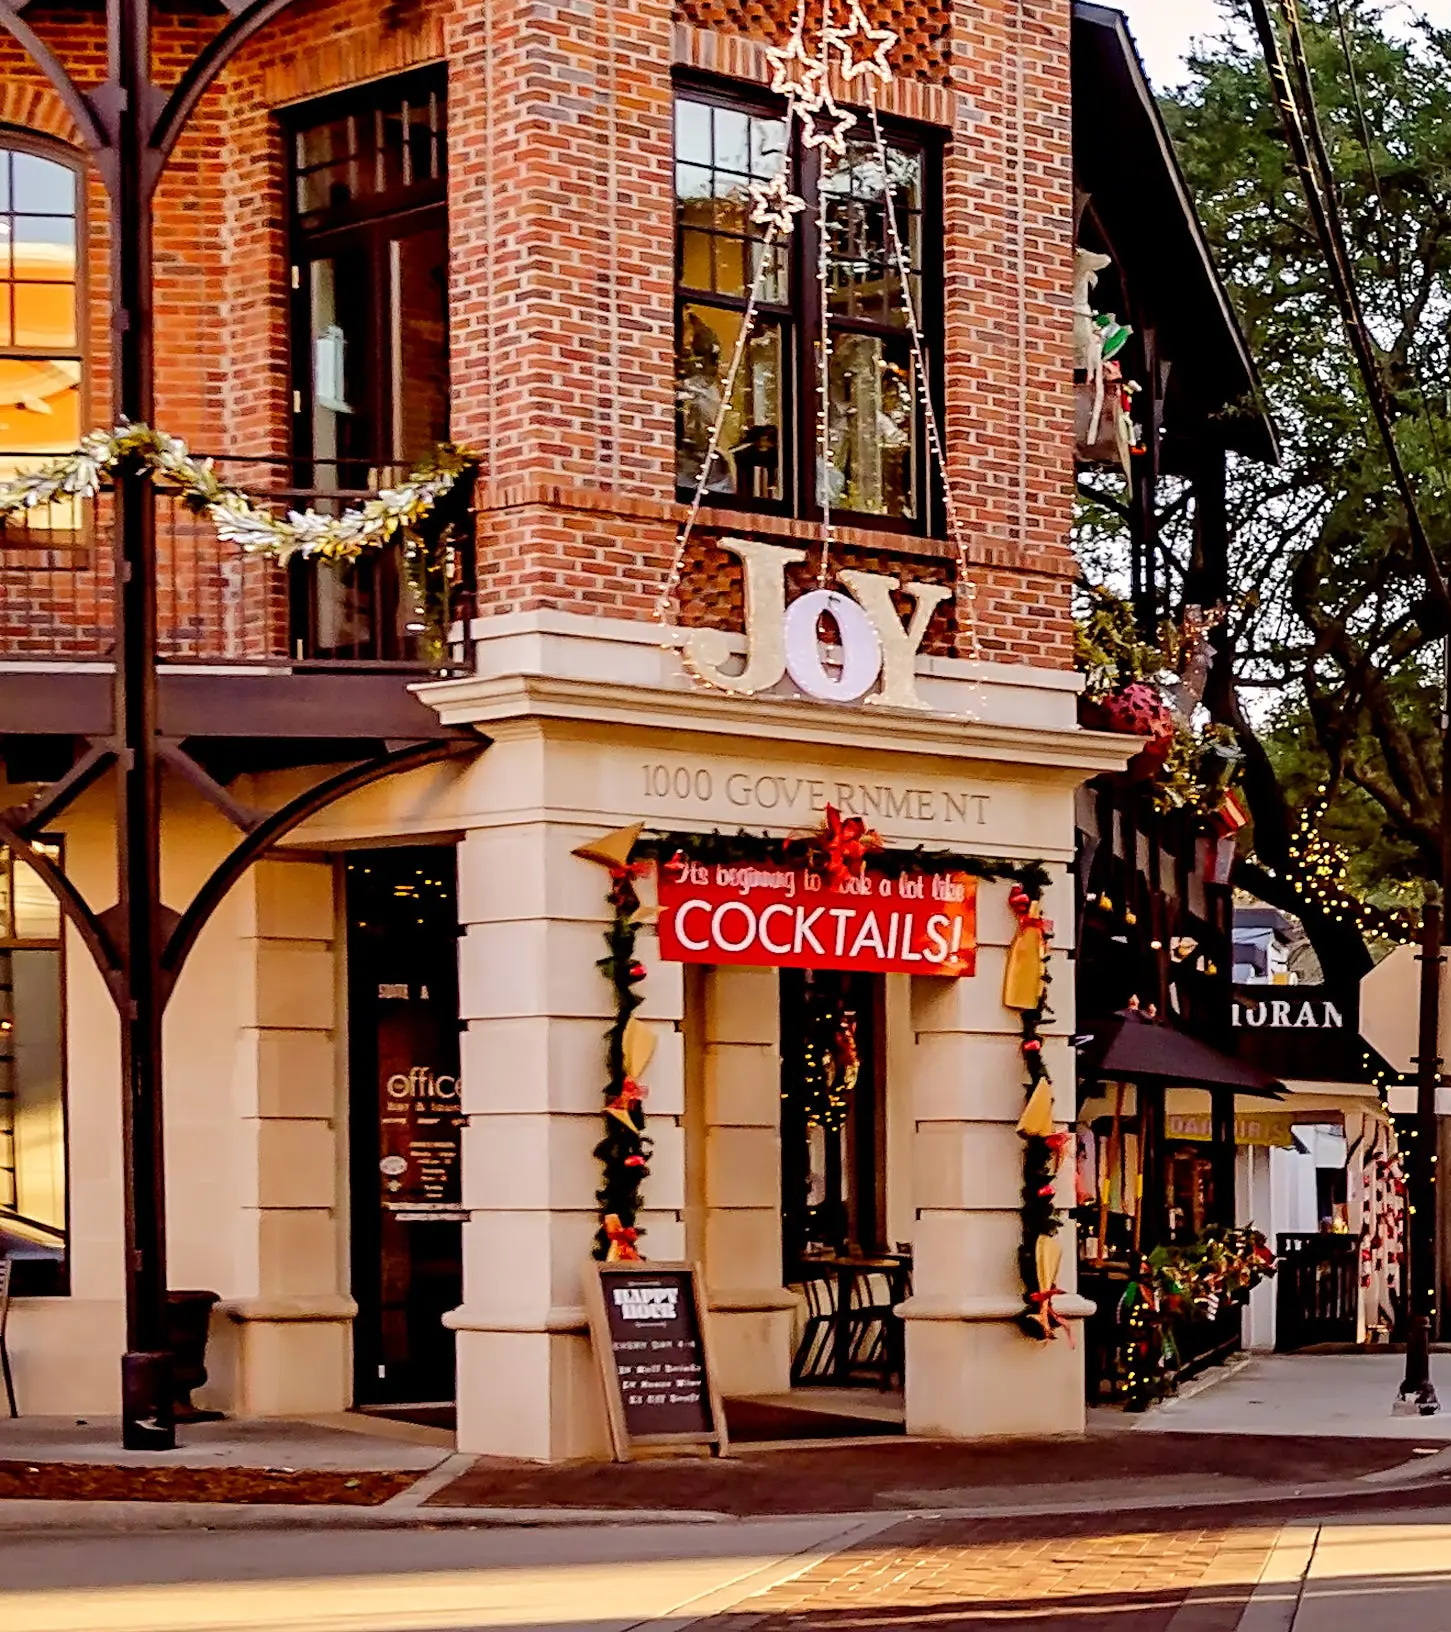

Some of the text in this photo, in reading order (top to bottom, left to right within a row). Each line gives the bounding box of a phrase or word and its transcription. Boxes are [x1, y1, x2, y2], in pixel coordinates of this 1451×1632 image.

[682, 536, 952, 710] JOY
[643, 764, 991, 825] 1000 GOVERNMENT
[804, 868, 821, 891] to
[879, 877, 891, 897] a
[899, 871, 924, 900] lot
[932, 872, 965, 903] like
[674, 899, 964, 964] COCKTAILS!
